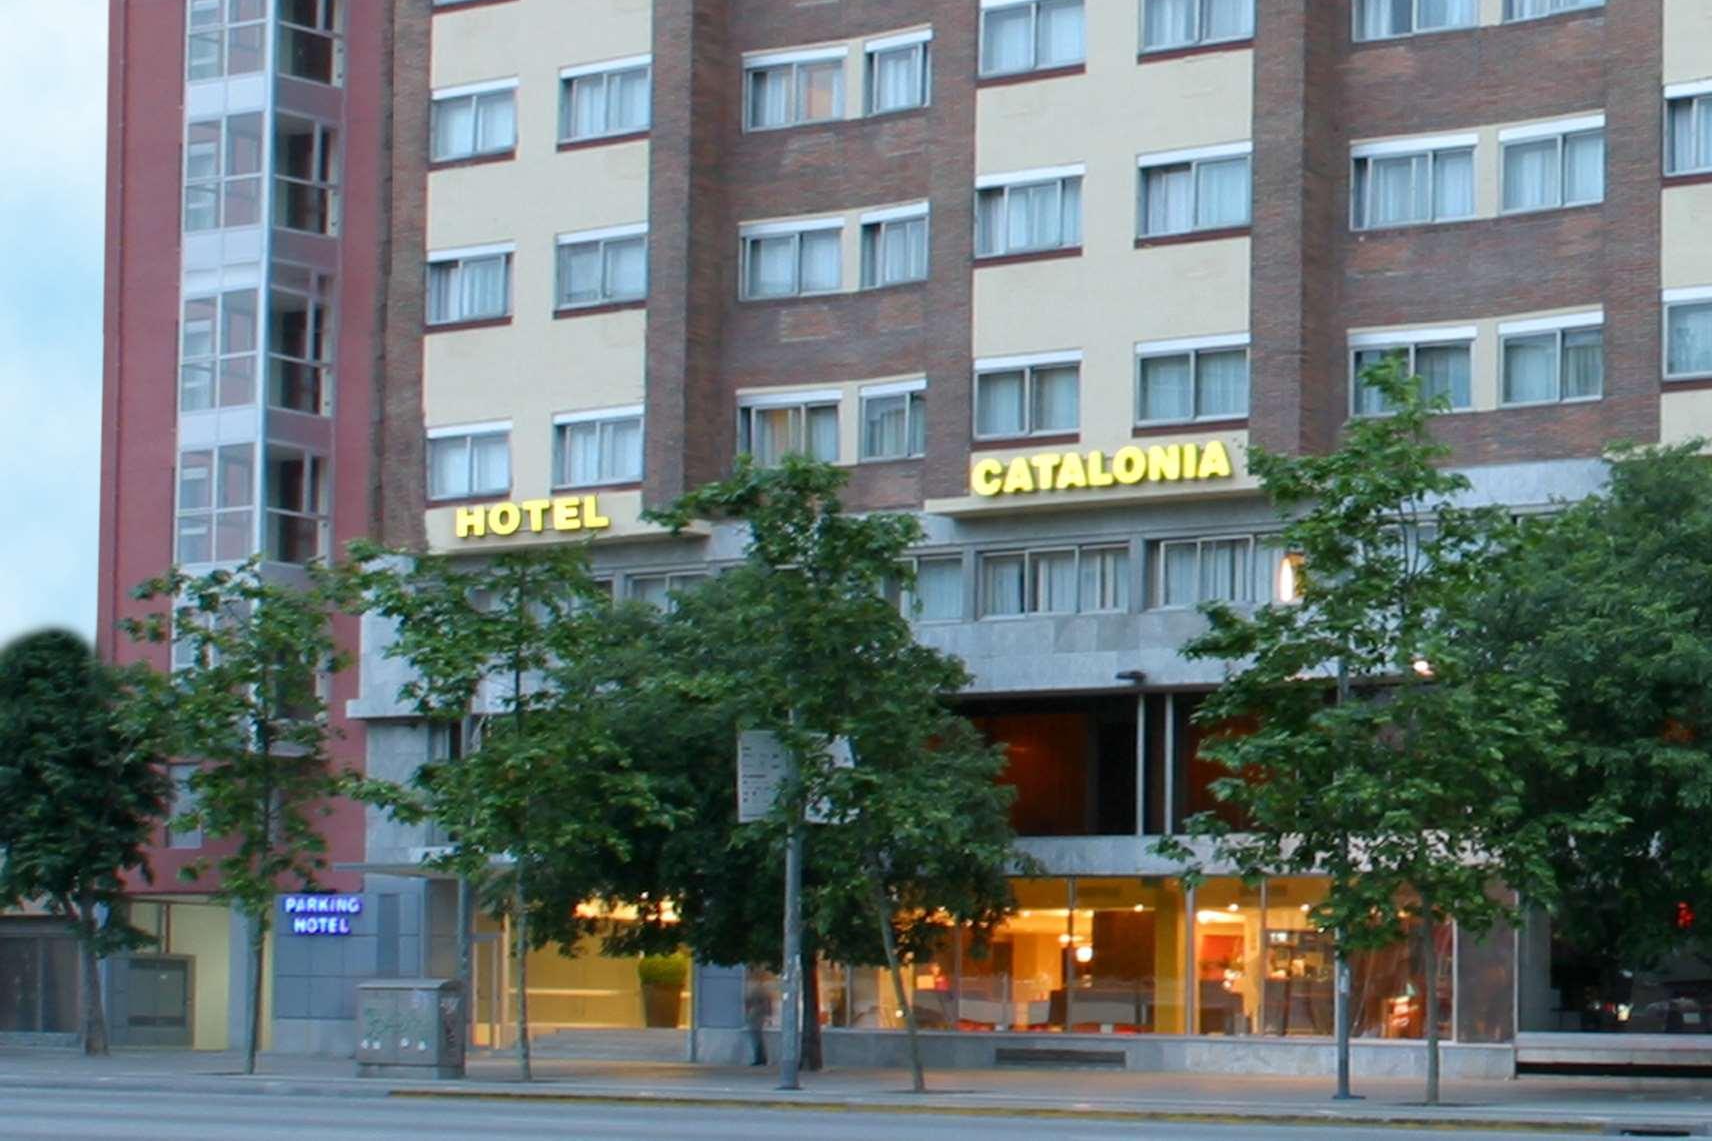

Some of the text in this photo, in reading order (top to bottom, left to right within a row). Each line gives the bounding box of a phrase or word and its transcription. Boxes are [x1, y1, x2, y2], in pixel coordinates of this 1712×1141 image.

[970, 440, 1232, 497] CATALONIA
[455, 495, 611, 538] HOTEL
[285, 897, 361, 913] PARKING
[293, 917, 350, 934] HOTEL
